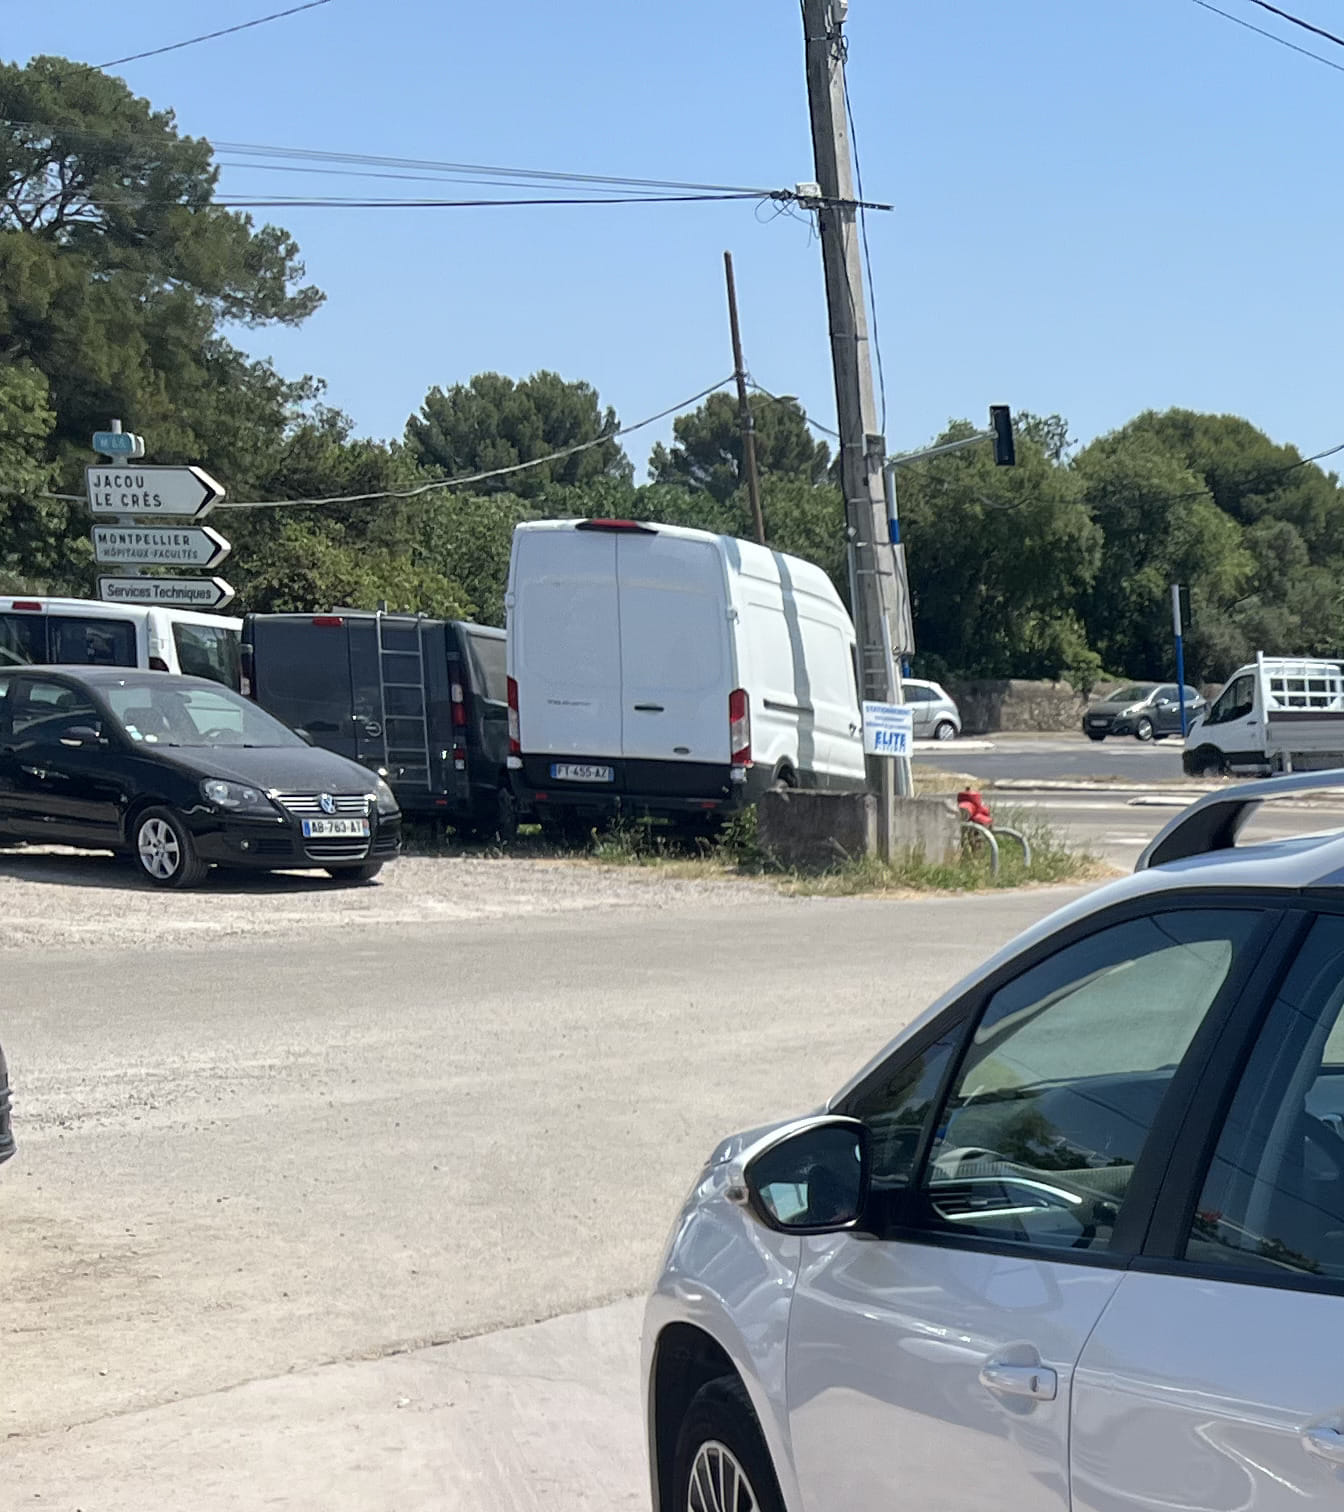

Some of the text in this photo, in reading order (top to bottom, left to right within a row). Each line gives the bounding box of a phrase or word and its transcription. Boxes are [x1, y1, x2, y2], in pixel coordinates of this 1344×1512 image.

[94, 475, 144, 489] JACOU
[95, 493, 112, 507] LE
[98, 533, 190, 546] MONTPELLIER
[107, 583, 212, 603] Services Techniques
